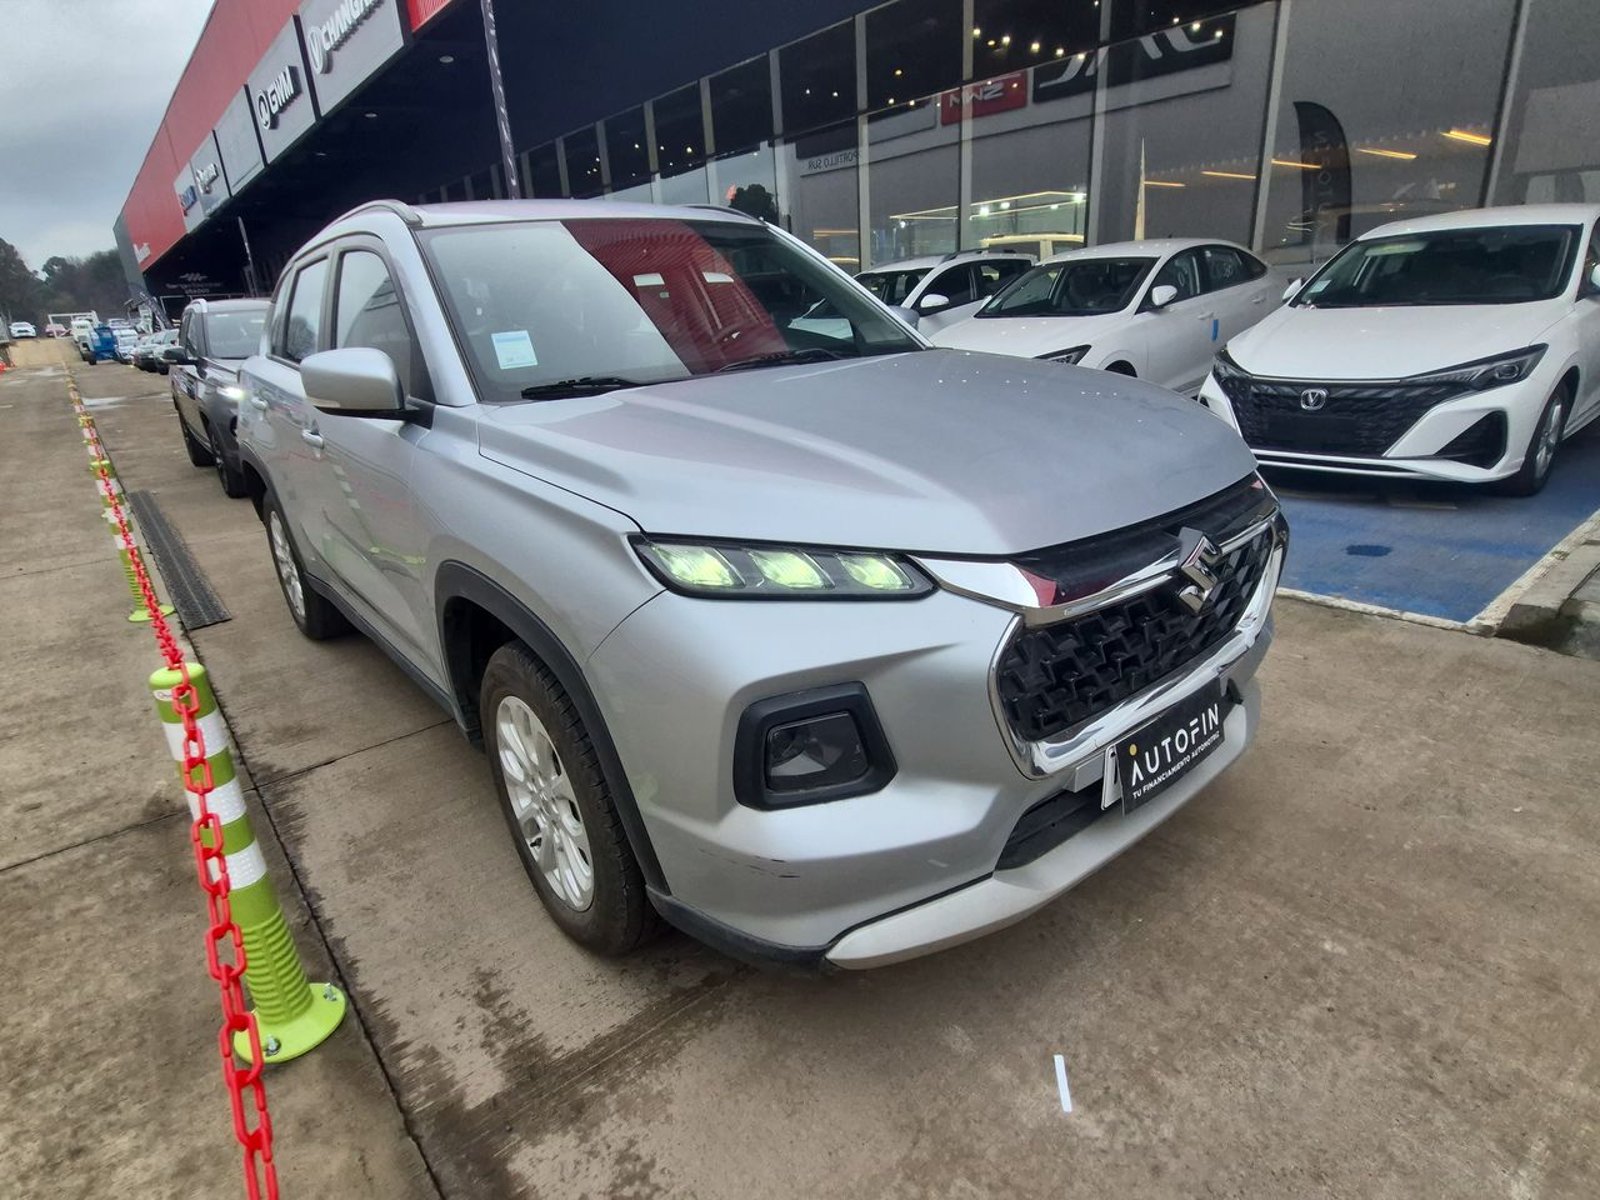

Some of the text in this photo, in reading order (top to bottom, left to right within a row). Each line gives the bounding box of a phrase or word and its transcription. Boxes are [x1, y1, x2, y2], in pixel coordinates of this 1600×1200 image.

[268, 65, 294, 114] GWM
[1129, 703, 1219, 787] AUTOFIN
[1132, 788, 1142, 799] TU
[1142, 754, 1190, 793] FINANCIAMIENTO
